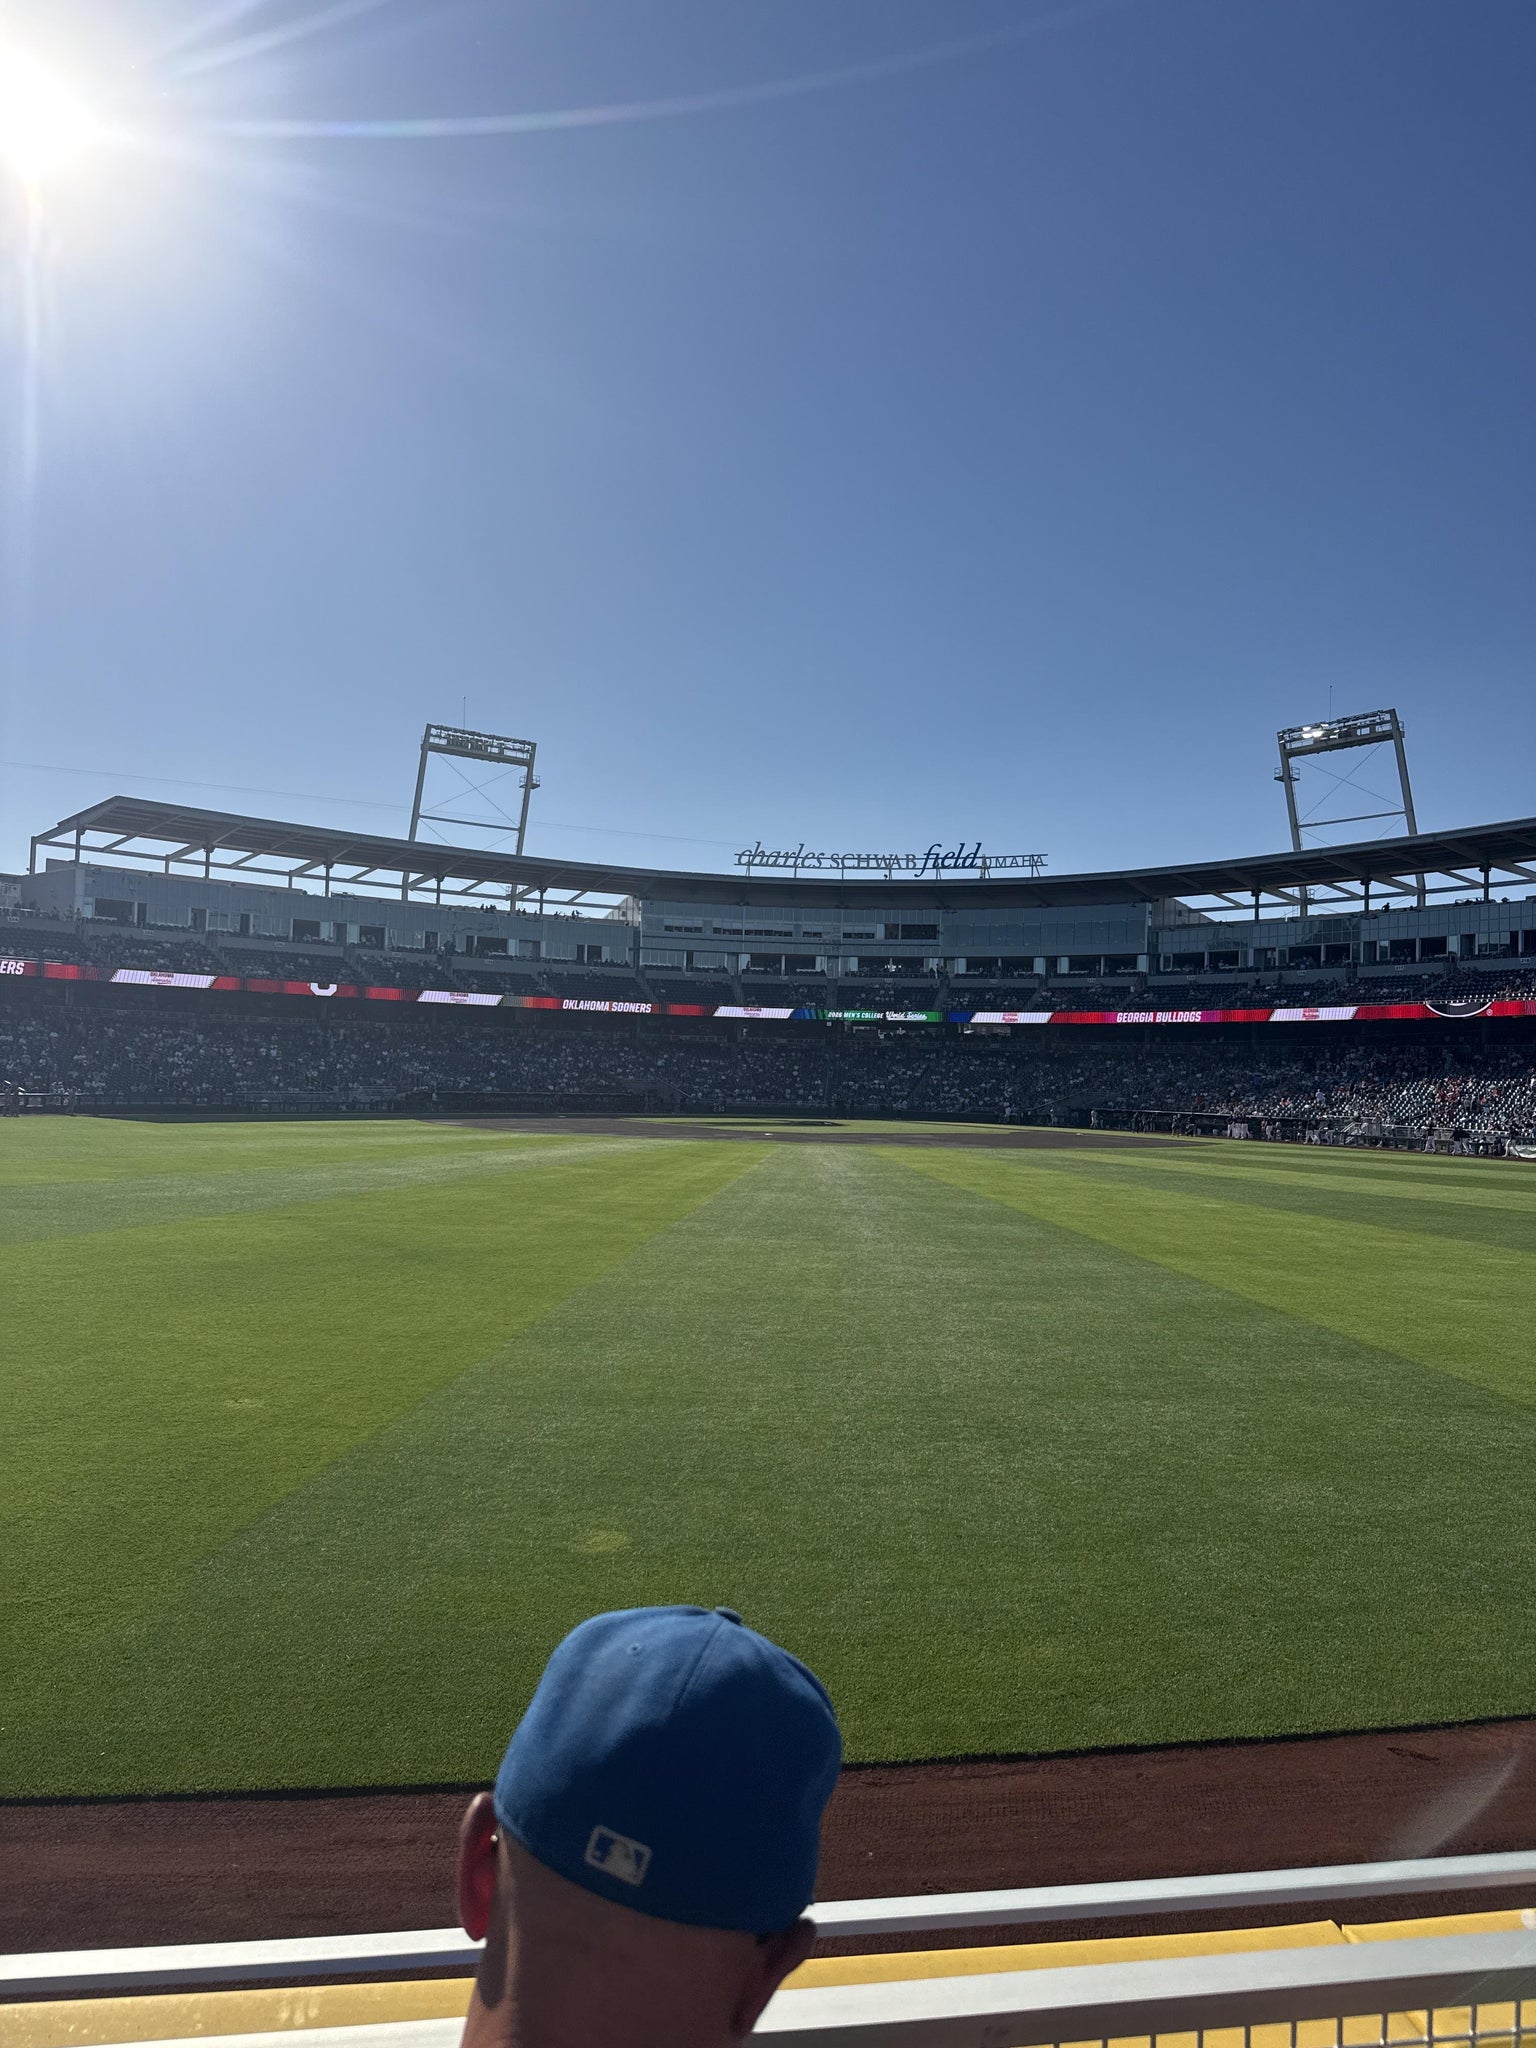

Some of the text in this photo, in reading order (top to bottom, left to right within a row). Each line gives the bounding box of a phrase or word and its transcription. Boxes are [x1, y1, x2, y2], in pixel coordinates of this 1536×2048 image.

[738, 841, 825, 867] charles
[830, 853, 917, 869] SCHWAB
[914, 843, 982, 877] field
[562, 999, 652, 1014] OKLAHOMA SOONERS
[1117, 1011, 1202, 1023] GEORGIA BULLDOGS
